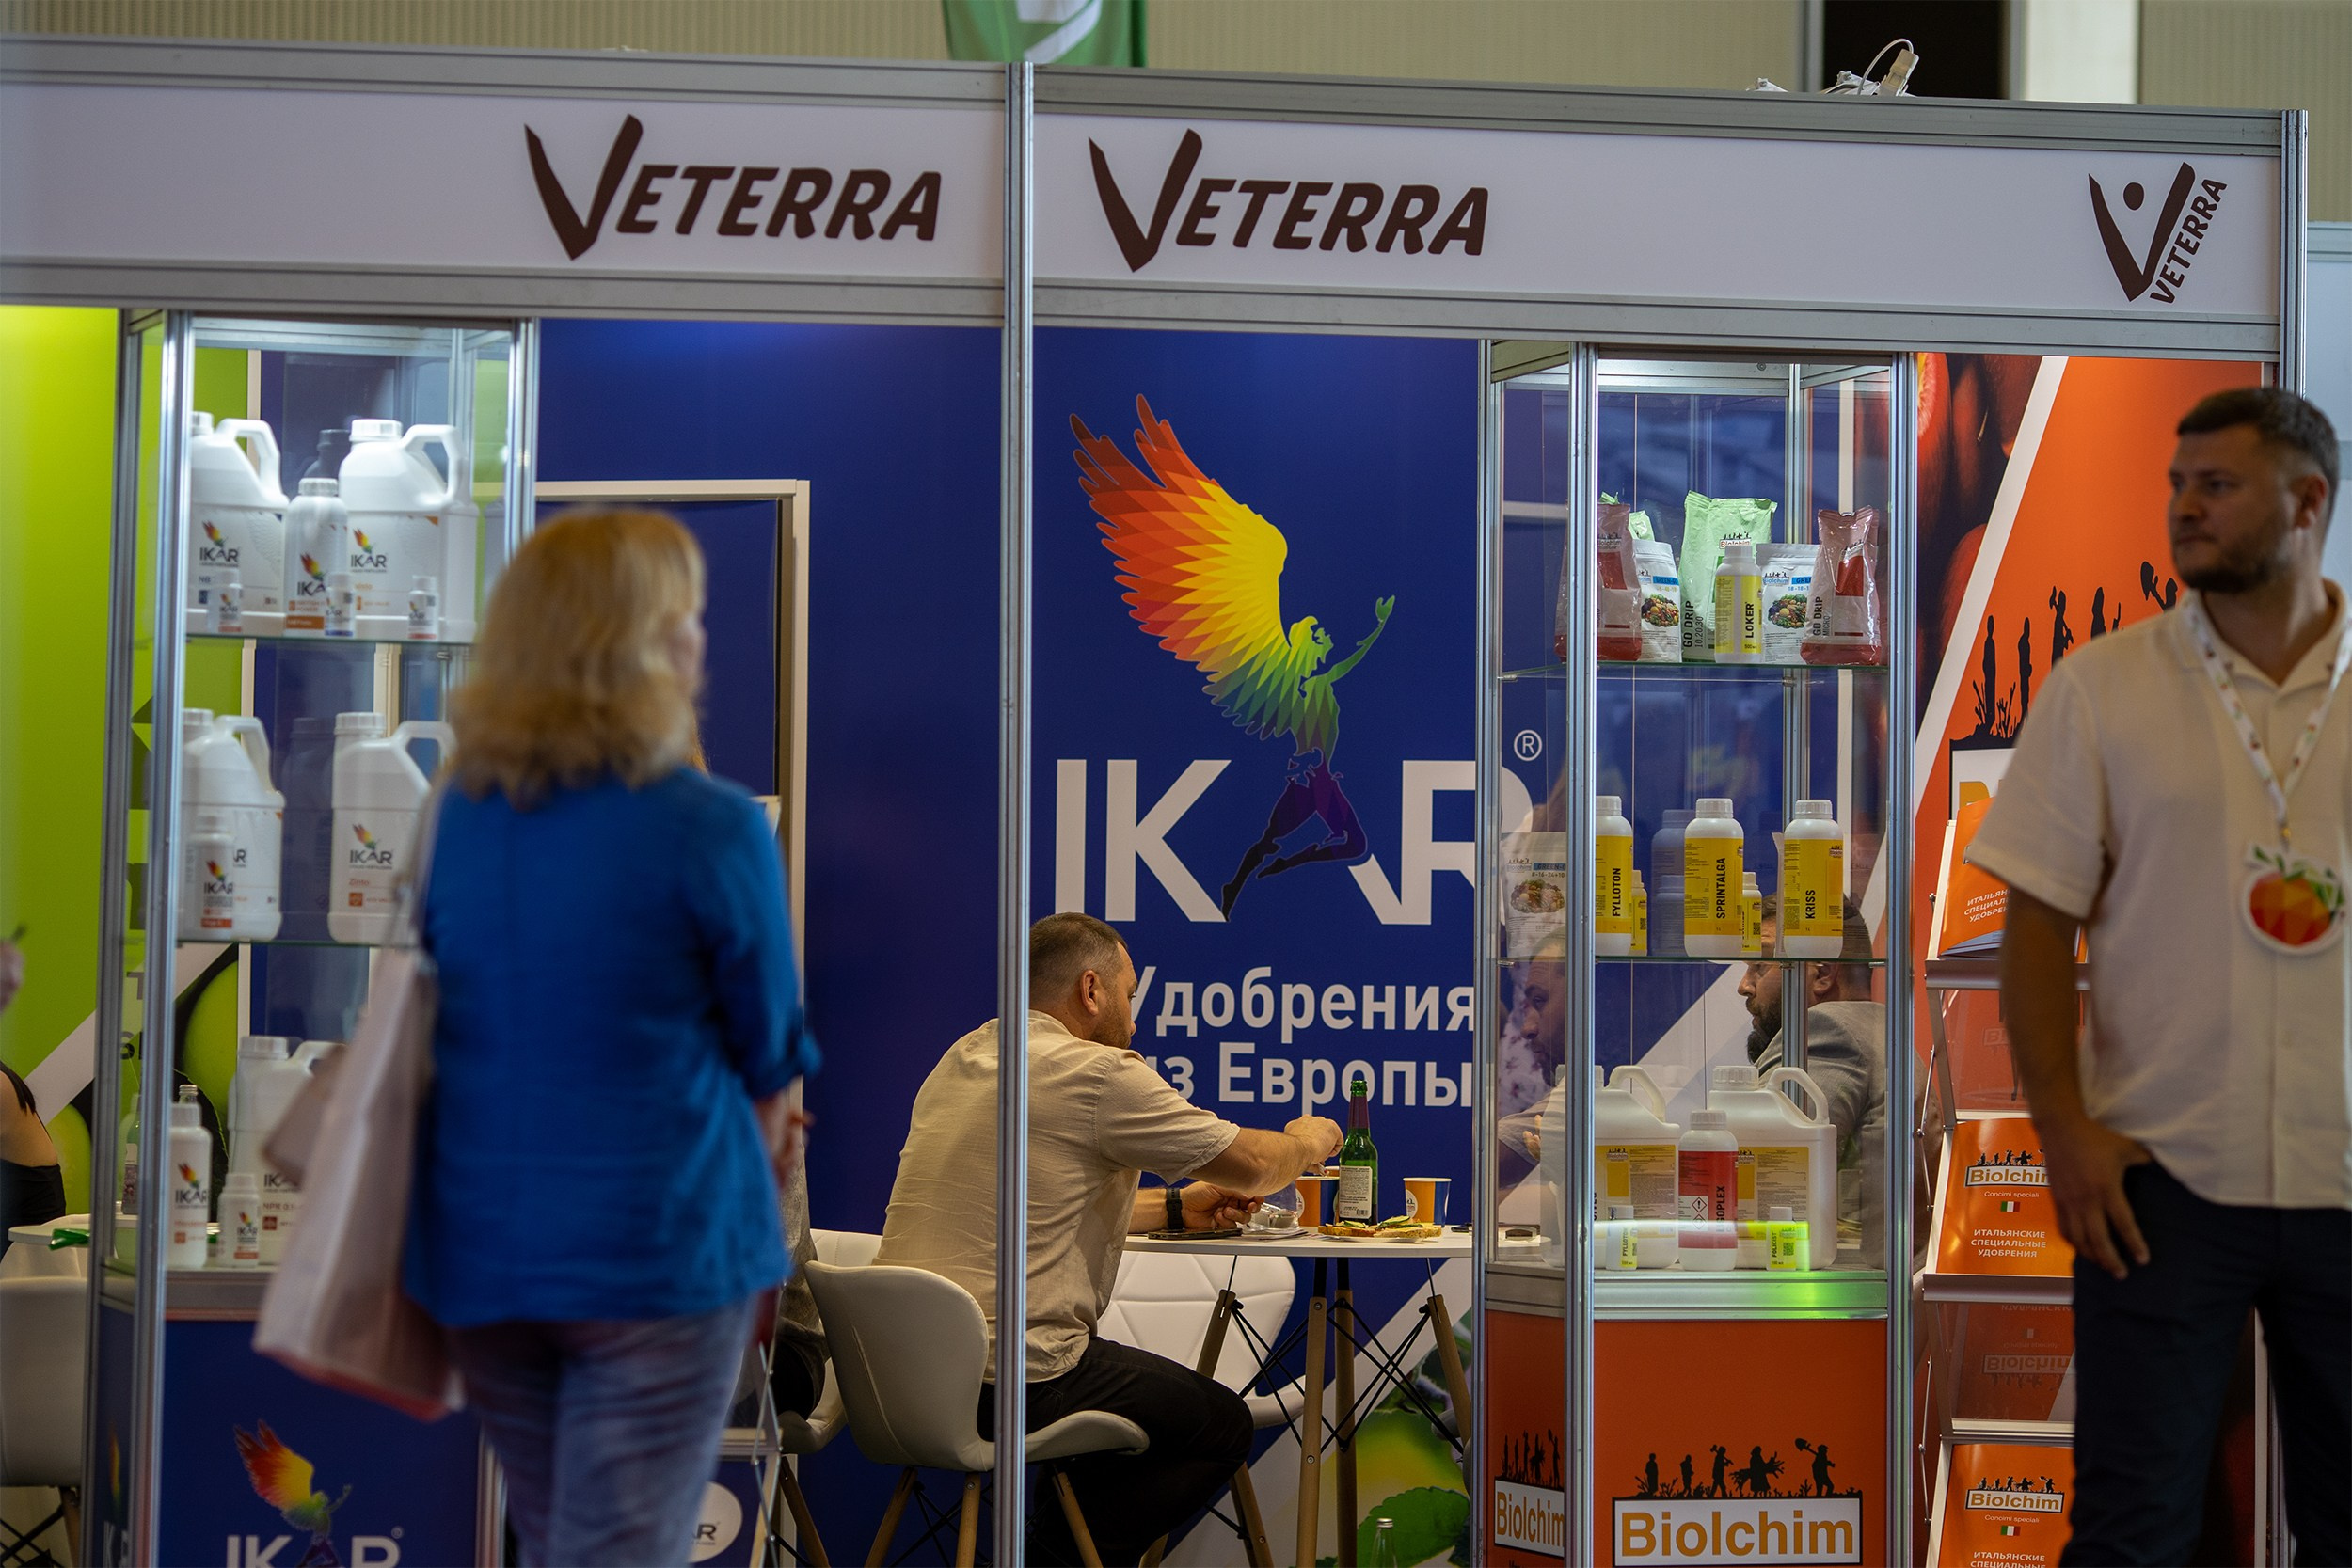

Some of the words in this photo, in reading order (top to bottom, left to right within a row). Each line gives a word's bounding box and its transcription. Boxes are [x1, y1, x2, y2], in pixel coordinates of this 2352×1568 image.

[524, 113, 942, 261] VETERRA
[1089, 128, 1489, 273] VETERRA
[2149, 178, 2228, 304] VETERRA
[199, 547, 239, 562] IKAR
[350, 554, 387, 568] IKAR
[297, 581, 326, 596] IKA
[1683, 600, 1694, 627] DRIP
[1745, 602, 1755, 639] LOKER
[1815, 596, 1823, 620] DRIP
[1683, 628, 1692, 648] GO
[1813, 619, 1821, 637] GO
[1055, 759, 1534, 925] IKAR
[350, 849, 393, 864] IKAR
[1612, 867, 1621, 917] FYLLOTON
[1716, 857, 1725, 919] SPRINTALGA
[1967, 888, 2008, 906] ИТАЛЬЯН
[1805, 889, 1816, 919] KRISS
[1145, 1055, 1195, 1101] з
[1218, 1041, 1472, 1117] Европы
[1715, 1185, 1725, 1232] LGOPLEX
[1970, 1239, 2047, 1249] СПЕЦИАЛЬНЫЕ
[1973, 1228, 2046, 1239] ИТАЛЬЯНСКИЕ
[1978, 1248, 2038, 1258] УДОБРЕНИЯ
[1971, 1493, 2059, 1510] Biolchim
[1497, 1491, 1565, 1548] Biolchim
[1621, 1509, 1853, 1558] Biolchim
[1973, 1551, 2045, 1561] ИТАЛЬЯНСКИЕ
